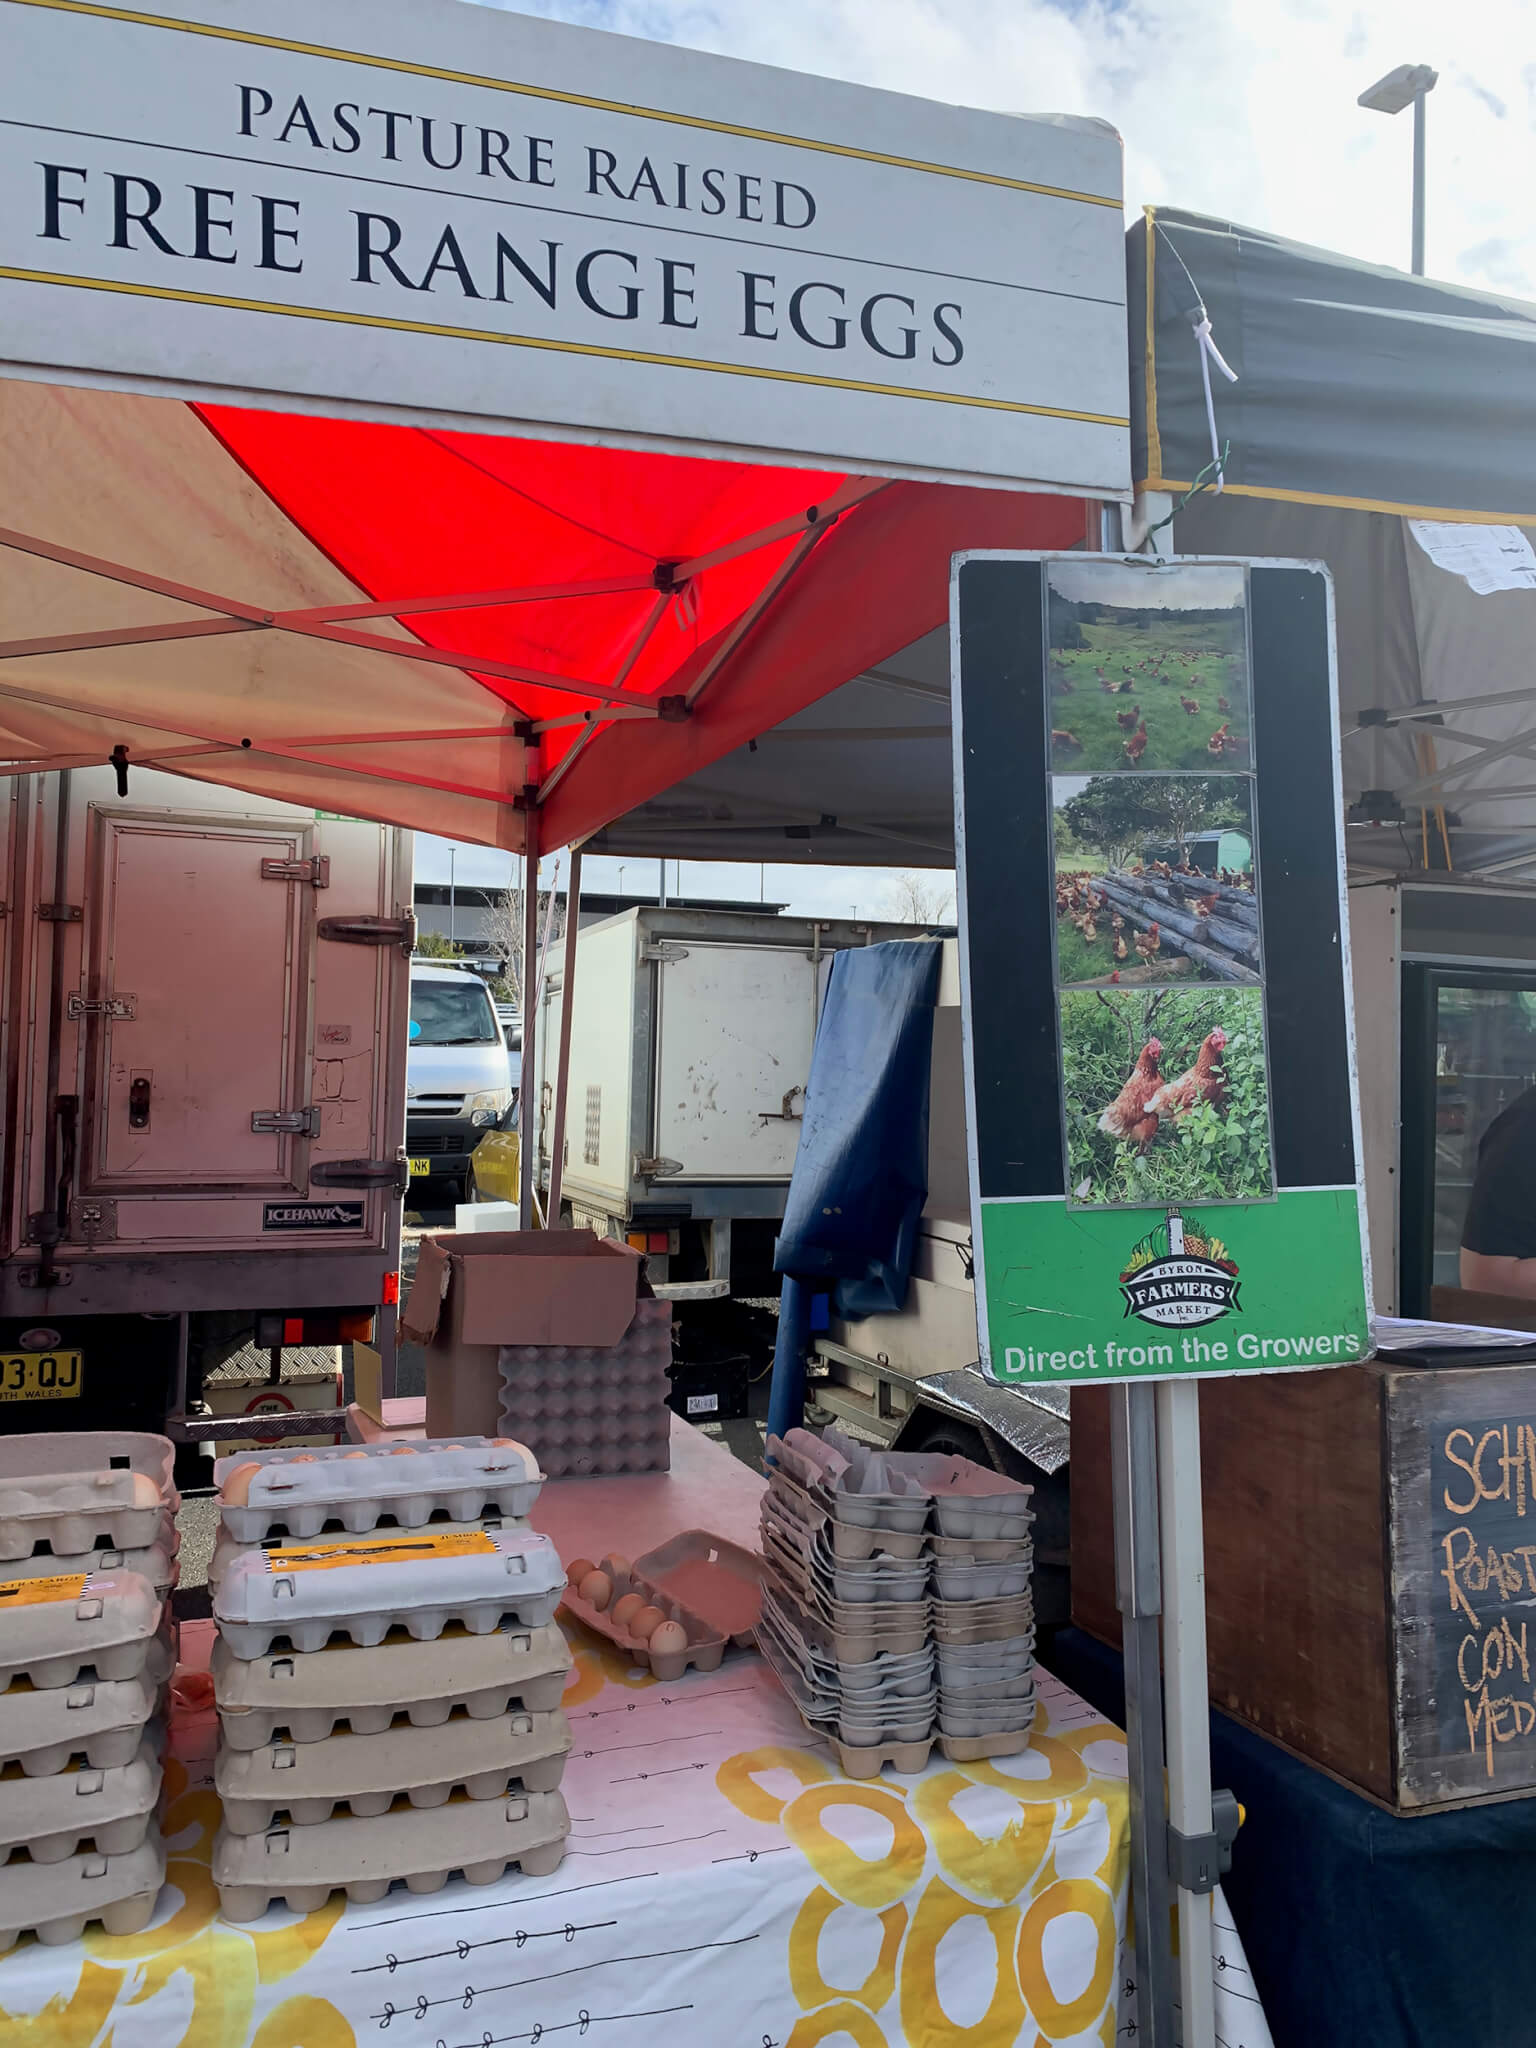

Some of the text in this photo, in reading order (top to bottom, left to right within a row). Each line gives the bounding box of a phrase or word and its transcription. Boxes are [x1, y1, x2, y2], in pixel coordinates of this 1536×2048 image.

[235, 84, 817, 229] PASTURE RAISED
[35, 161, 965, 366] FREE RANGE EGGS
[267, 1207, 338, 1222] ICEHAWK
[1160, 1265, 1203, 1276] BYRON
[1135, 1282, 1230, 1306] FARMERS'
[1155, 1305, 1211, 1318] MARKET
[1004, 1332, 1361, 1374] Direct from the Growers
[25, 1389, 62, 1399] WALES
[261, 1404, 279, 1412] THE
